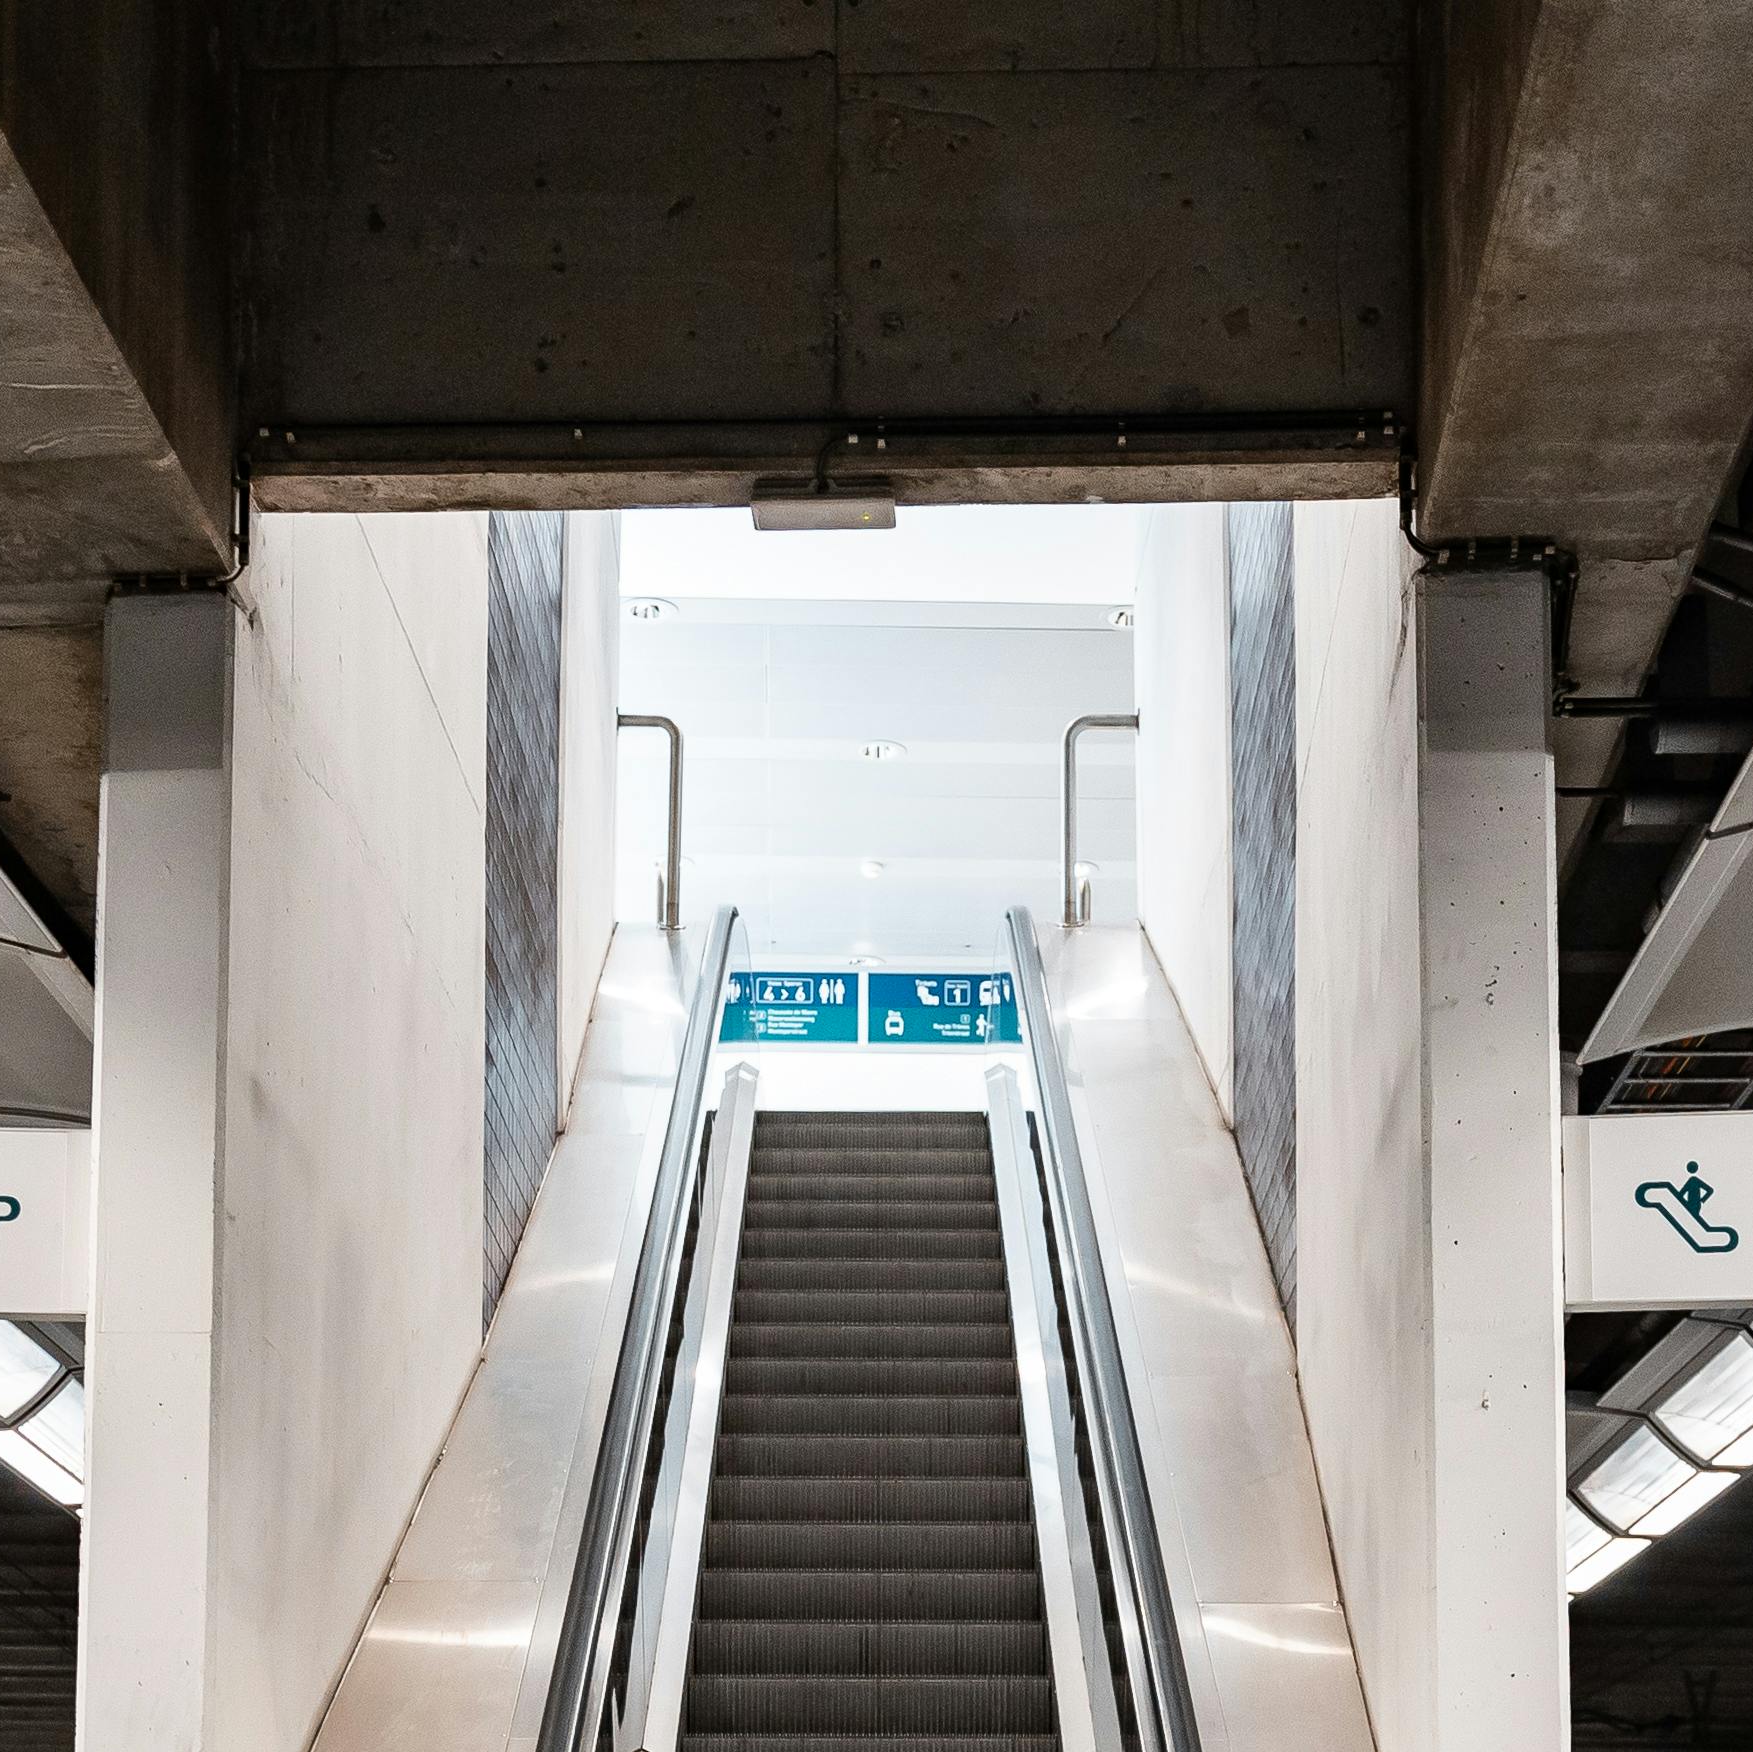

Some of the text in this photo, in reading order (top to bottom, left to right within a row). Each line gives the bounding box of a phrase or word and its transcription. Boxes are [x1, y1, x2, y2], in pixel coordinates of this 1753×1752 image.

[763, 986, 775, 1001] 4
[795, 986, 806, 1002] 6
[953, 988, 961, 1004] 1
